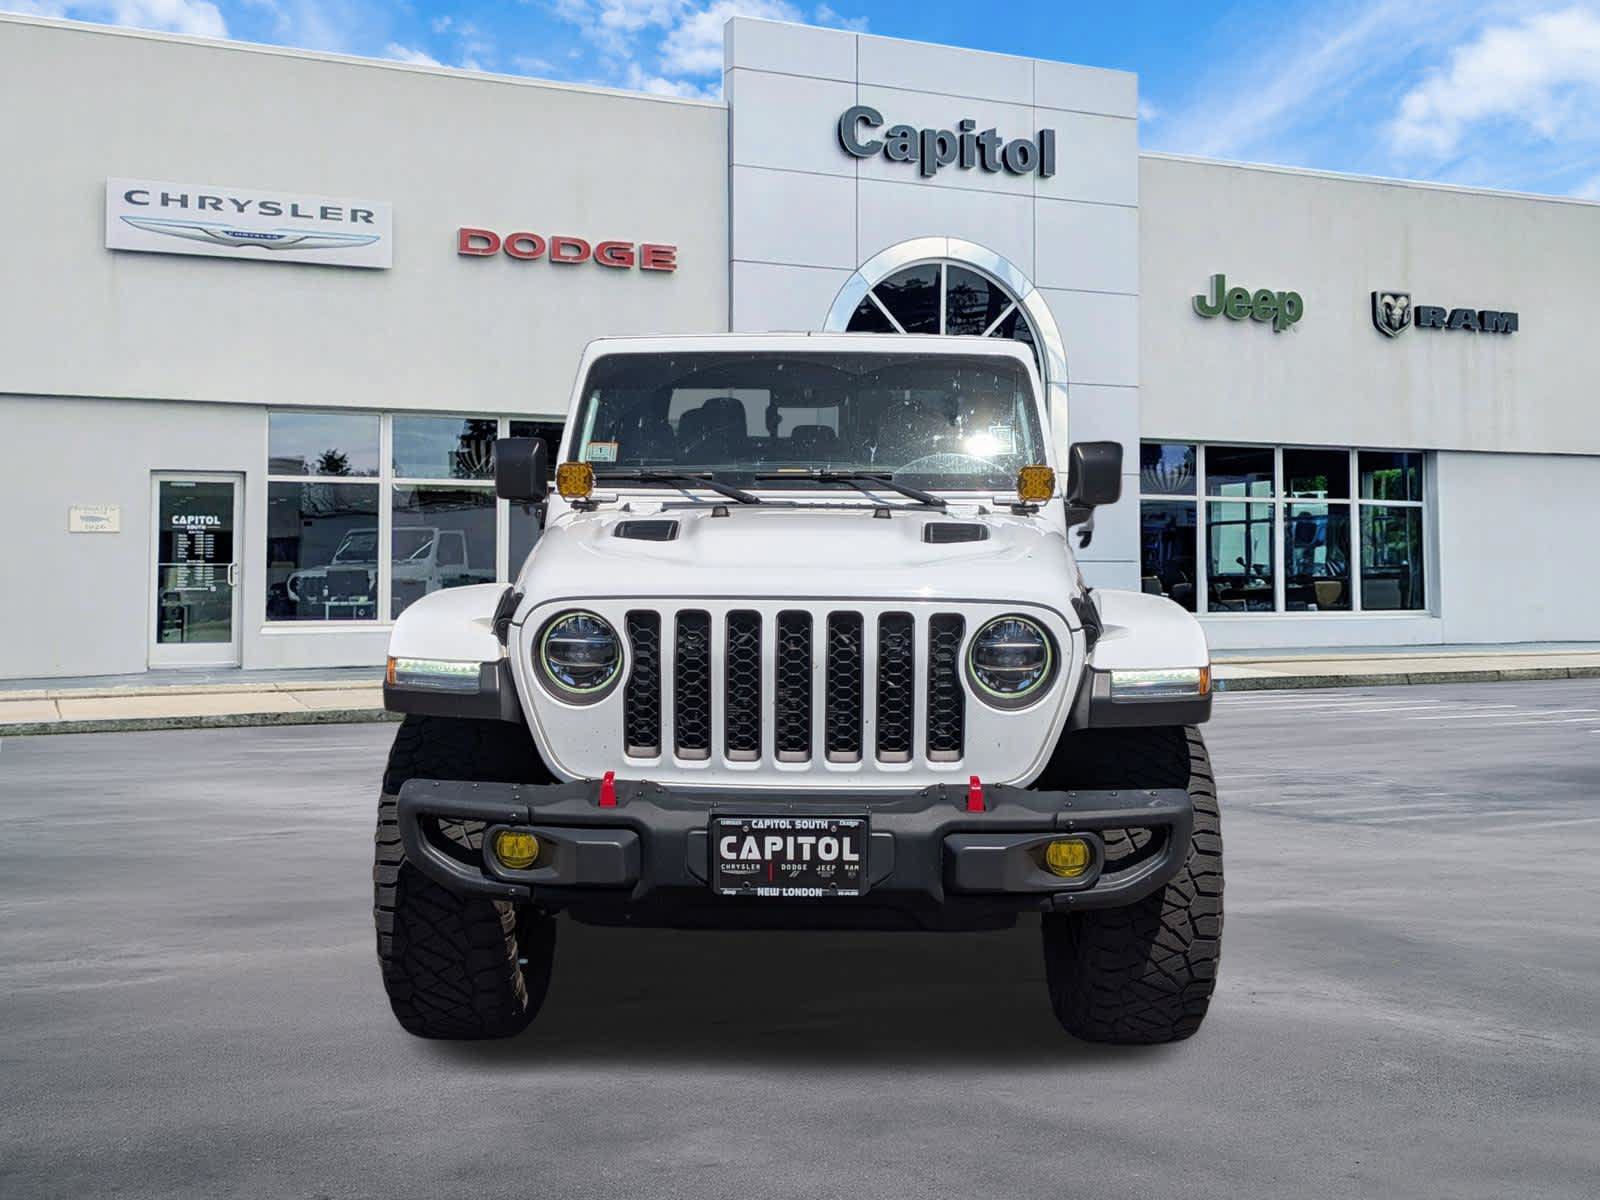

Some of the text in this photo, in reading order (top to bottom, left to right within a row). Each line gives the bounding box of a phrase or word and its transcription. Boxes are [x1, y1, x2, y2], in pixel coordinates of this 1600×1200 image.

[838, 105, 1056, 178] Capitol
[123, 189, 375, 224] CHRYSLER
[457, 227, 678, 272] DODGE
[1192, 273, 1304, 333] Jeep
[1414, 304, 1519, 334] RAM
[171, 515, 221, 525] CAPITOL
[751, 819, 792, 829] CAPITOL
[795, 819, 828, 830] SOUTH
[719, 835, 860, 861] CAPITOL
[781, 863, 808, 871] DODGE
[816, 864, 837, 872] JEEP
[757, 887, 823, 897] NEW LONDON
